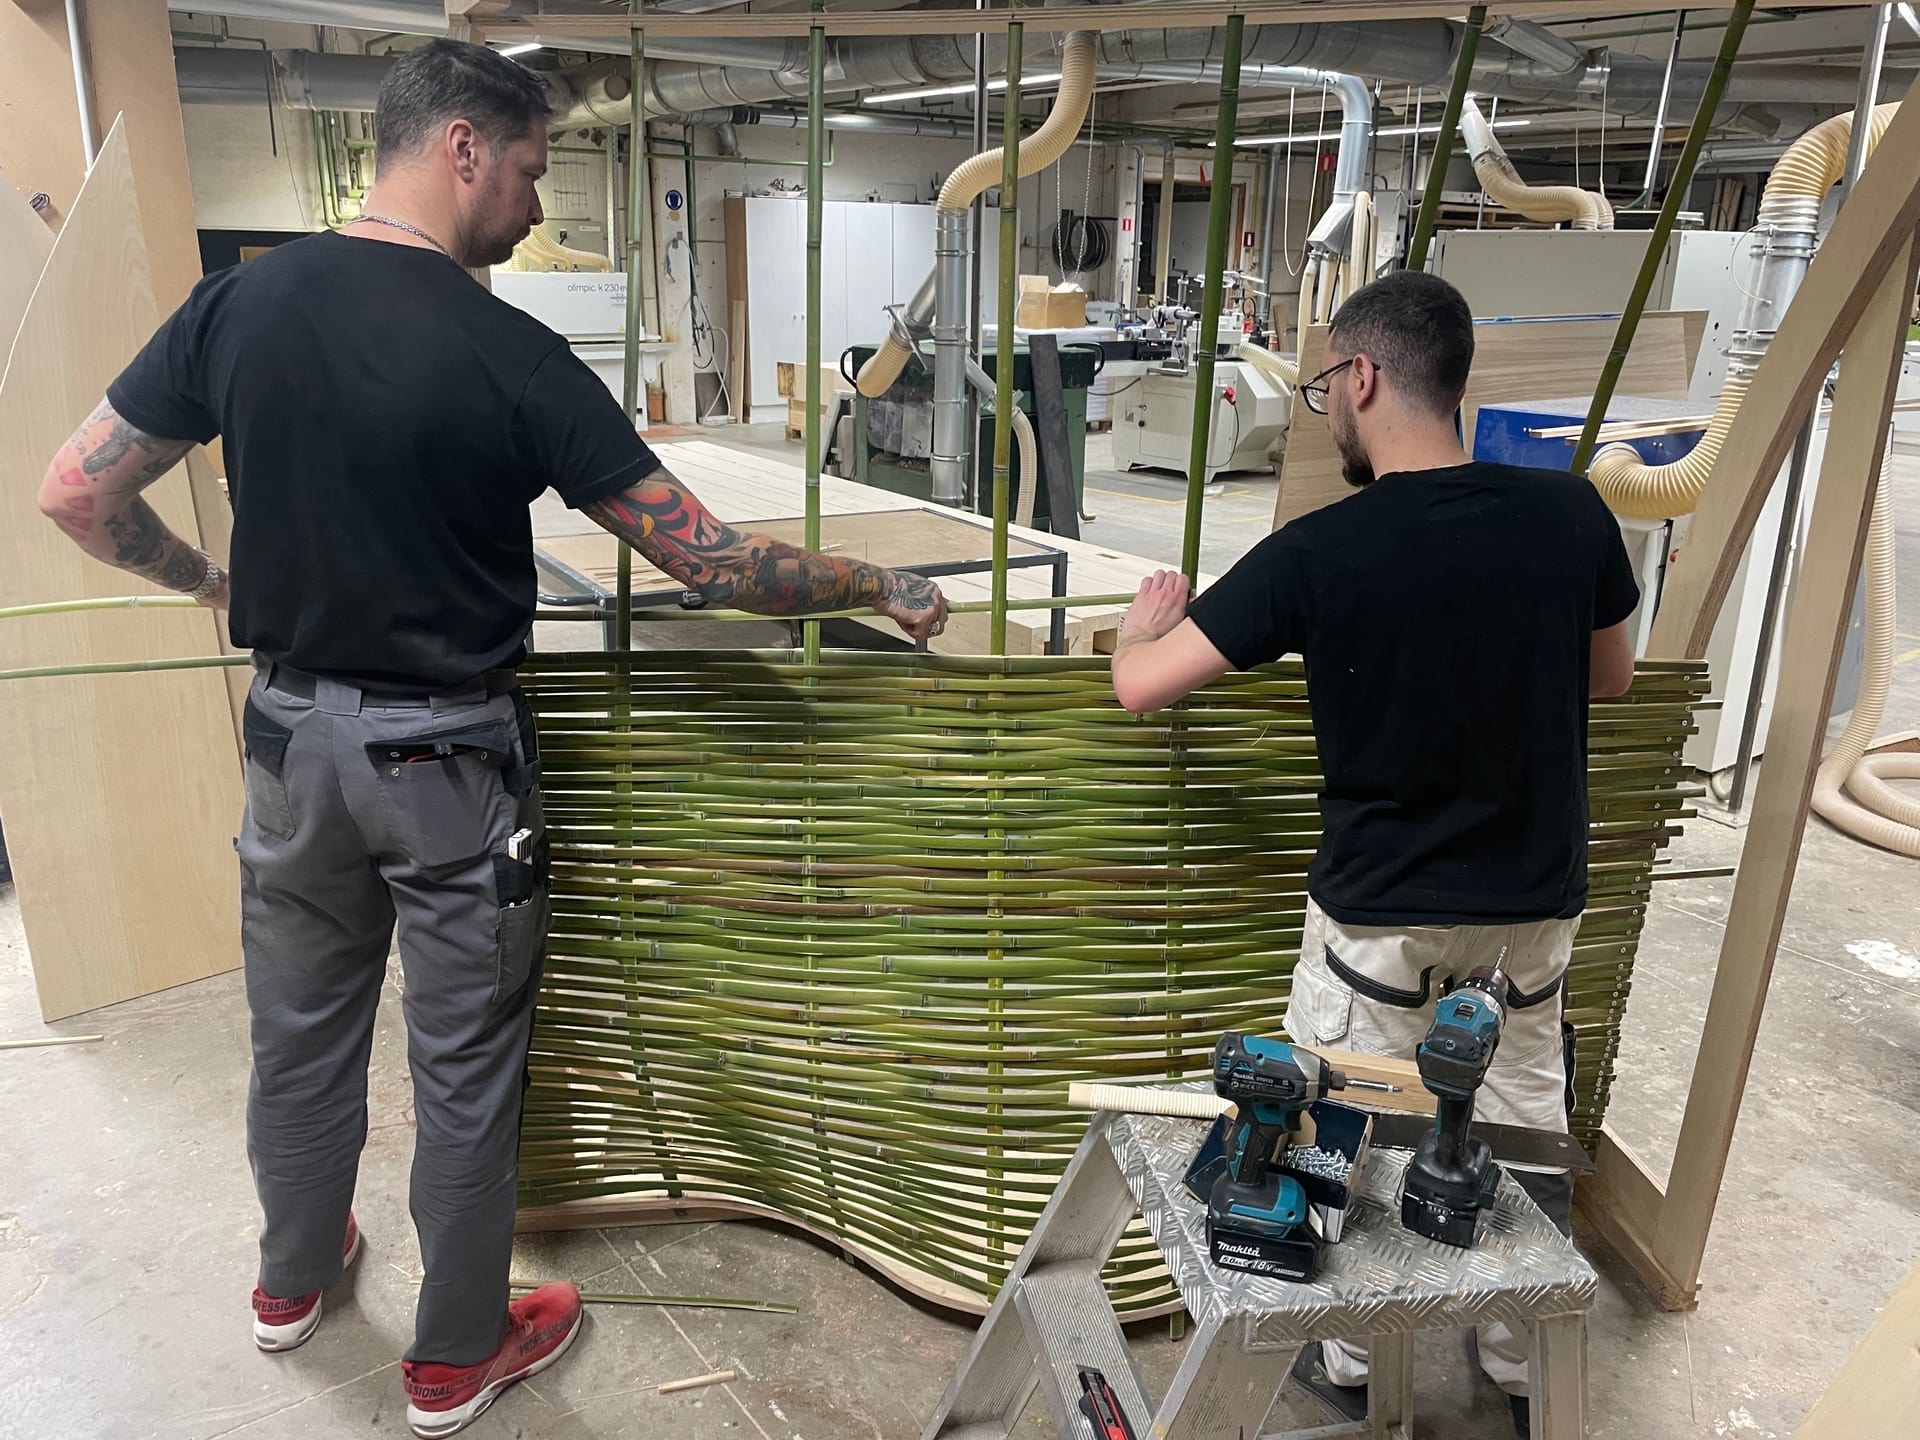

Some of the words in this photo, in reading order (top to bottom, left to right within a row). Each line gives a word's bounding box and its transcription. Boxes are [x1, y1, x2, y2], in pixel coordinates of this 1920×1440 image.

[567, 283, 596, 293] olimpic
[599, 284, 604, 292] k
[604, 284, 619, 292] 230
